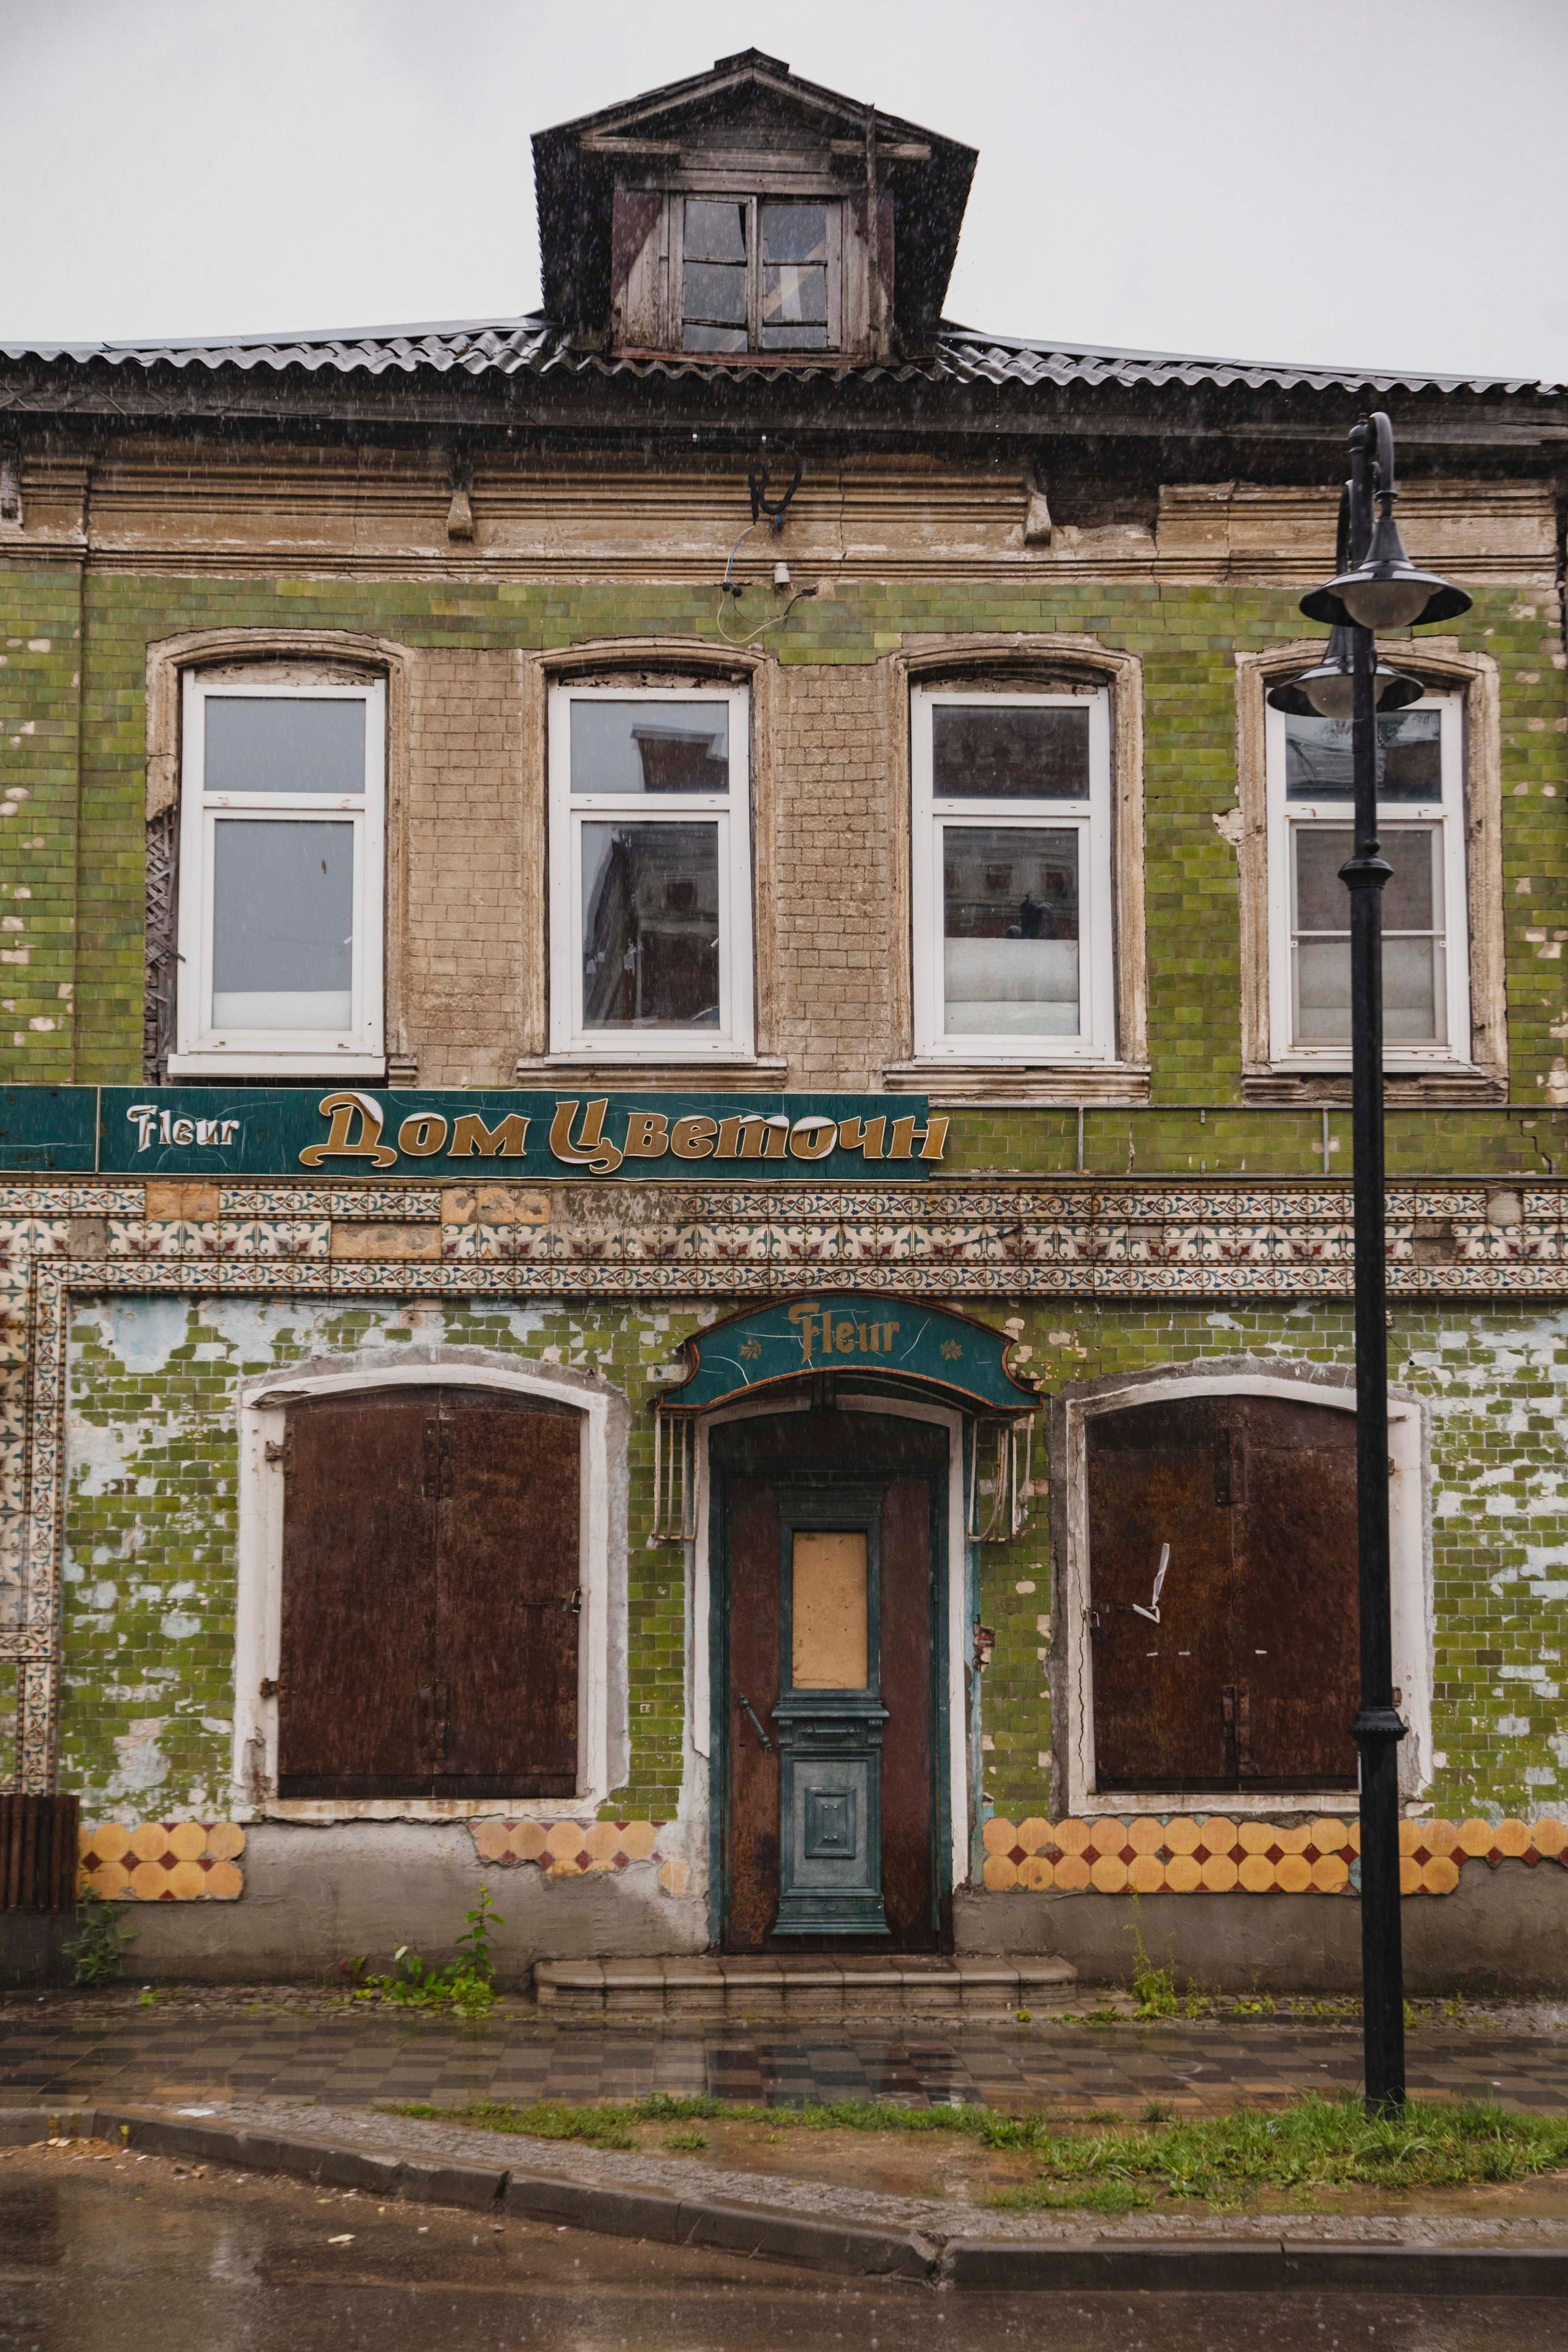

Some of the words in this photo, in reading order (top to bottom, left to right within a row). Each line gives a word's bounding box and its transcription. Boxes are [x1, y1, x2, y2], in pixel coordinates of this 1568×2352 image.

[127, 1105, 240, 1152] Fleur
[299, 1093, 531, 1166] Дом
[789, 1303, 900, 1363] Fleur
